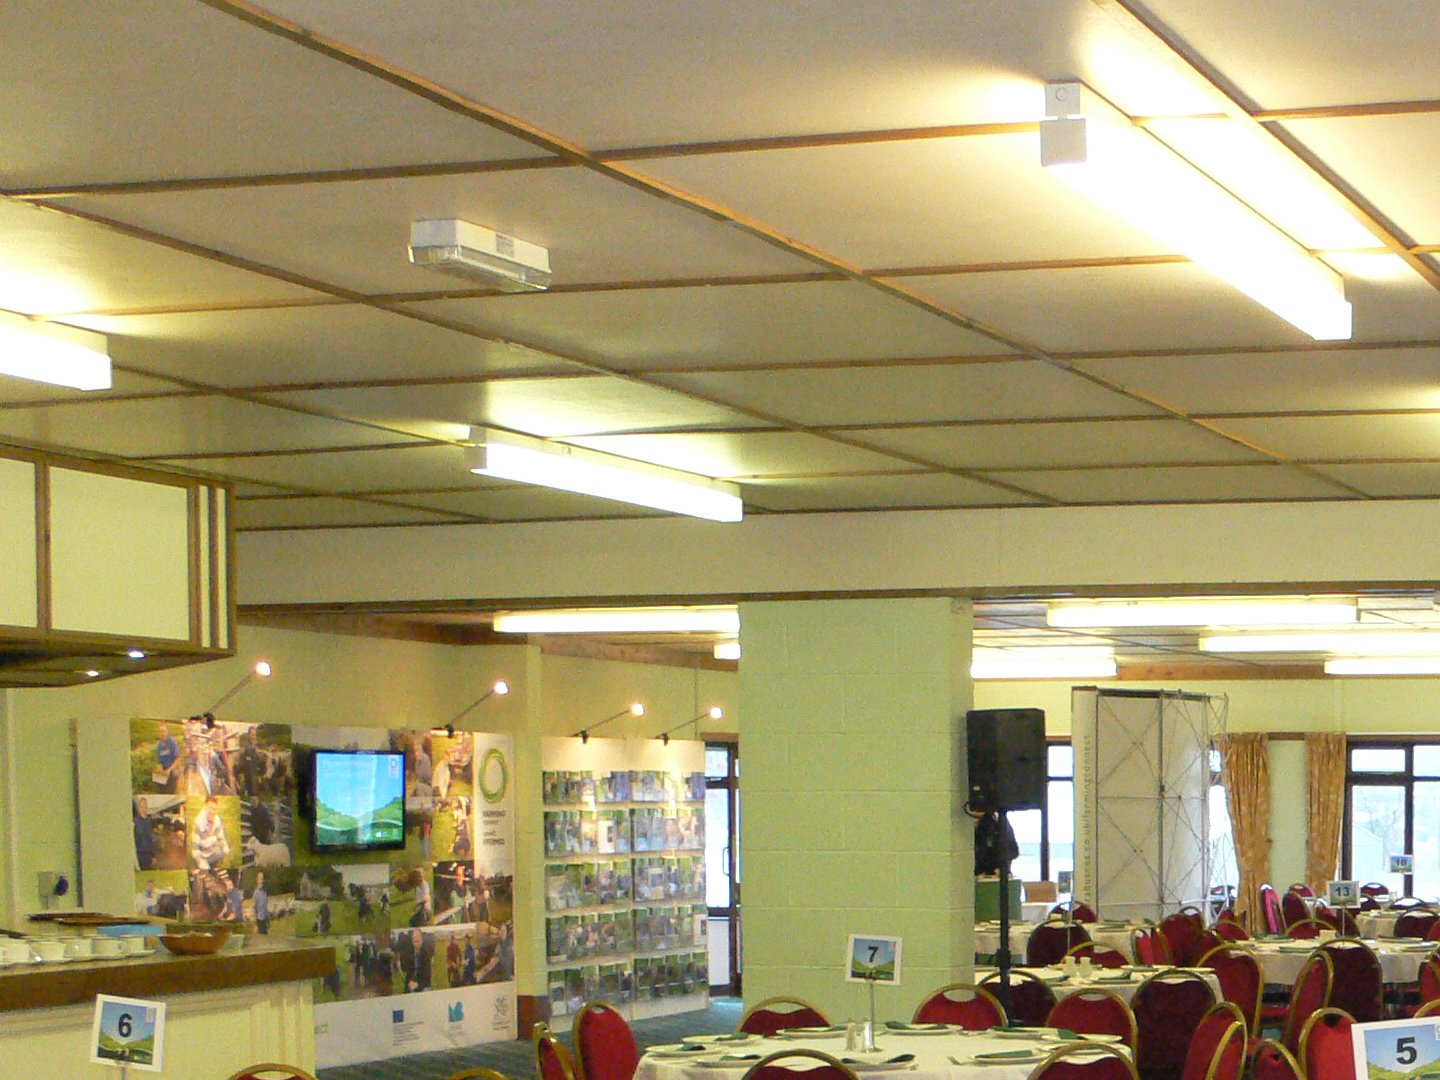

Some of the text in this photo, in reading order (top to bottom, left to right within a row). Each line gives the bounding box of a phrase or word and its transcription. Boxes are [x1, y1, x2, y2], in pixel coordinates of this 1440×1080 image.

[1335, 886, 1349, 897] 13
[868, 946, 879, 963] 7
[118, 1013, 132, 1038] 6
[1396, 1036, 1417, 1065] 5
